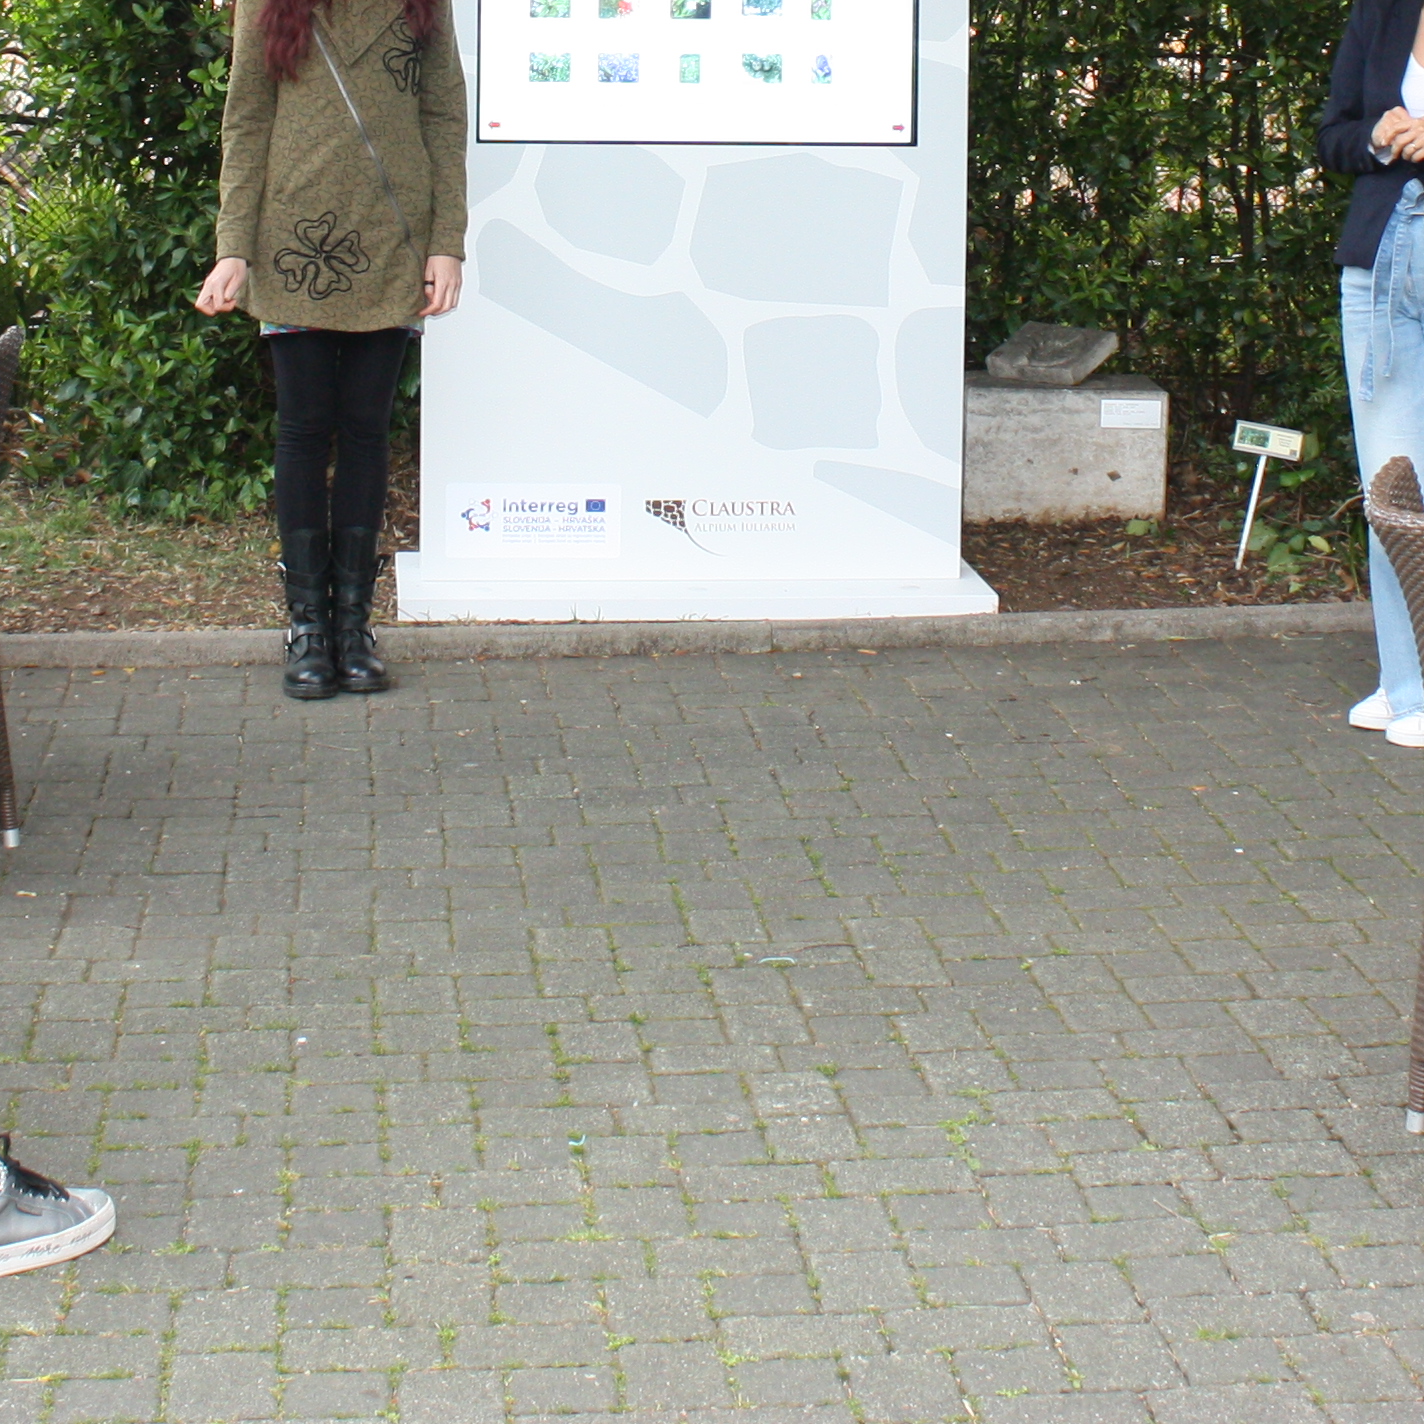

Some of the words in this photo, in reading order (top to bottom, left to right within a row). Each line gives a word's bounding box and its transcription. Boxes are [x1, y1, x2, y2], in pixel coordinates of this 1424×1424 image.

[502, 498, 579, 515] Interreg
[692, 498, 796, 516] CLAUSTRA
[502, 516, 551, 524] SLOVENIJA
[562, 514, 606, 524] HRVAŠKA
[502, 525, 551, 533] SLOVENIJA
[558, 525, 606, 533] HRVATSKA
[694, 522, 736, 532] ALPIUM
[741, 521, 796, 532] IULIARUM
